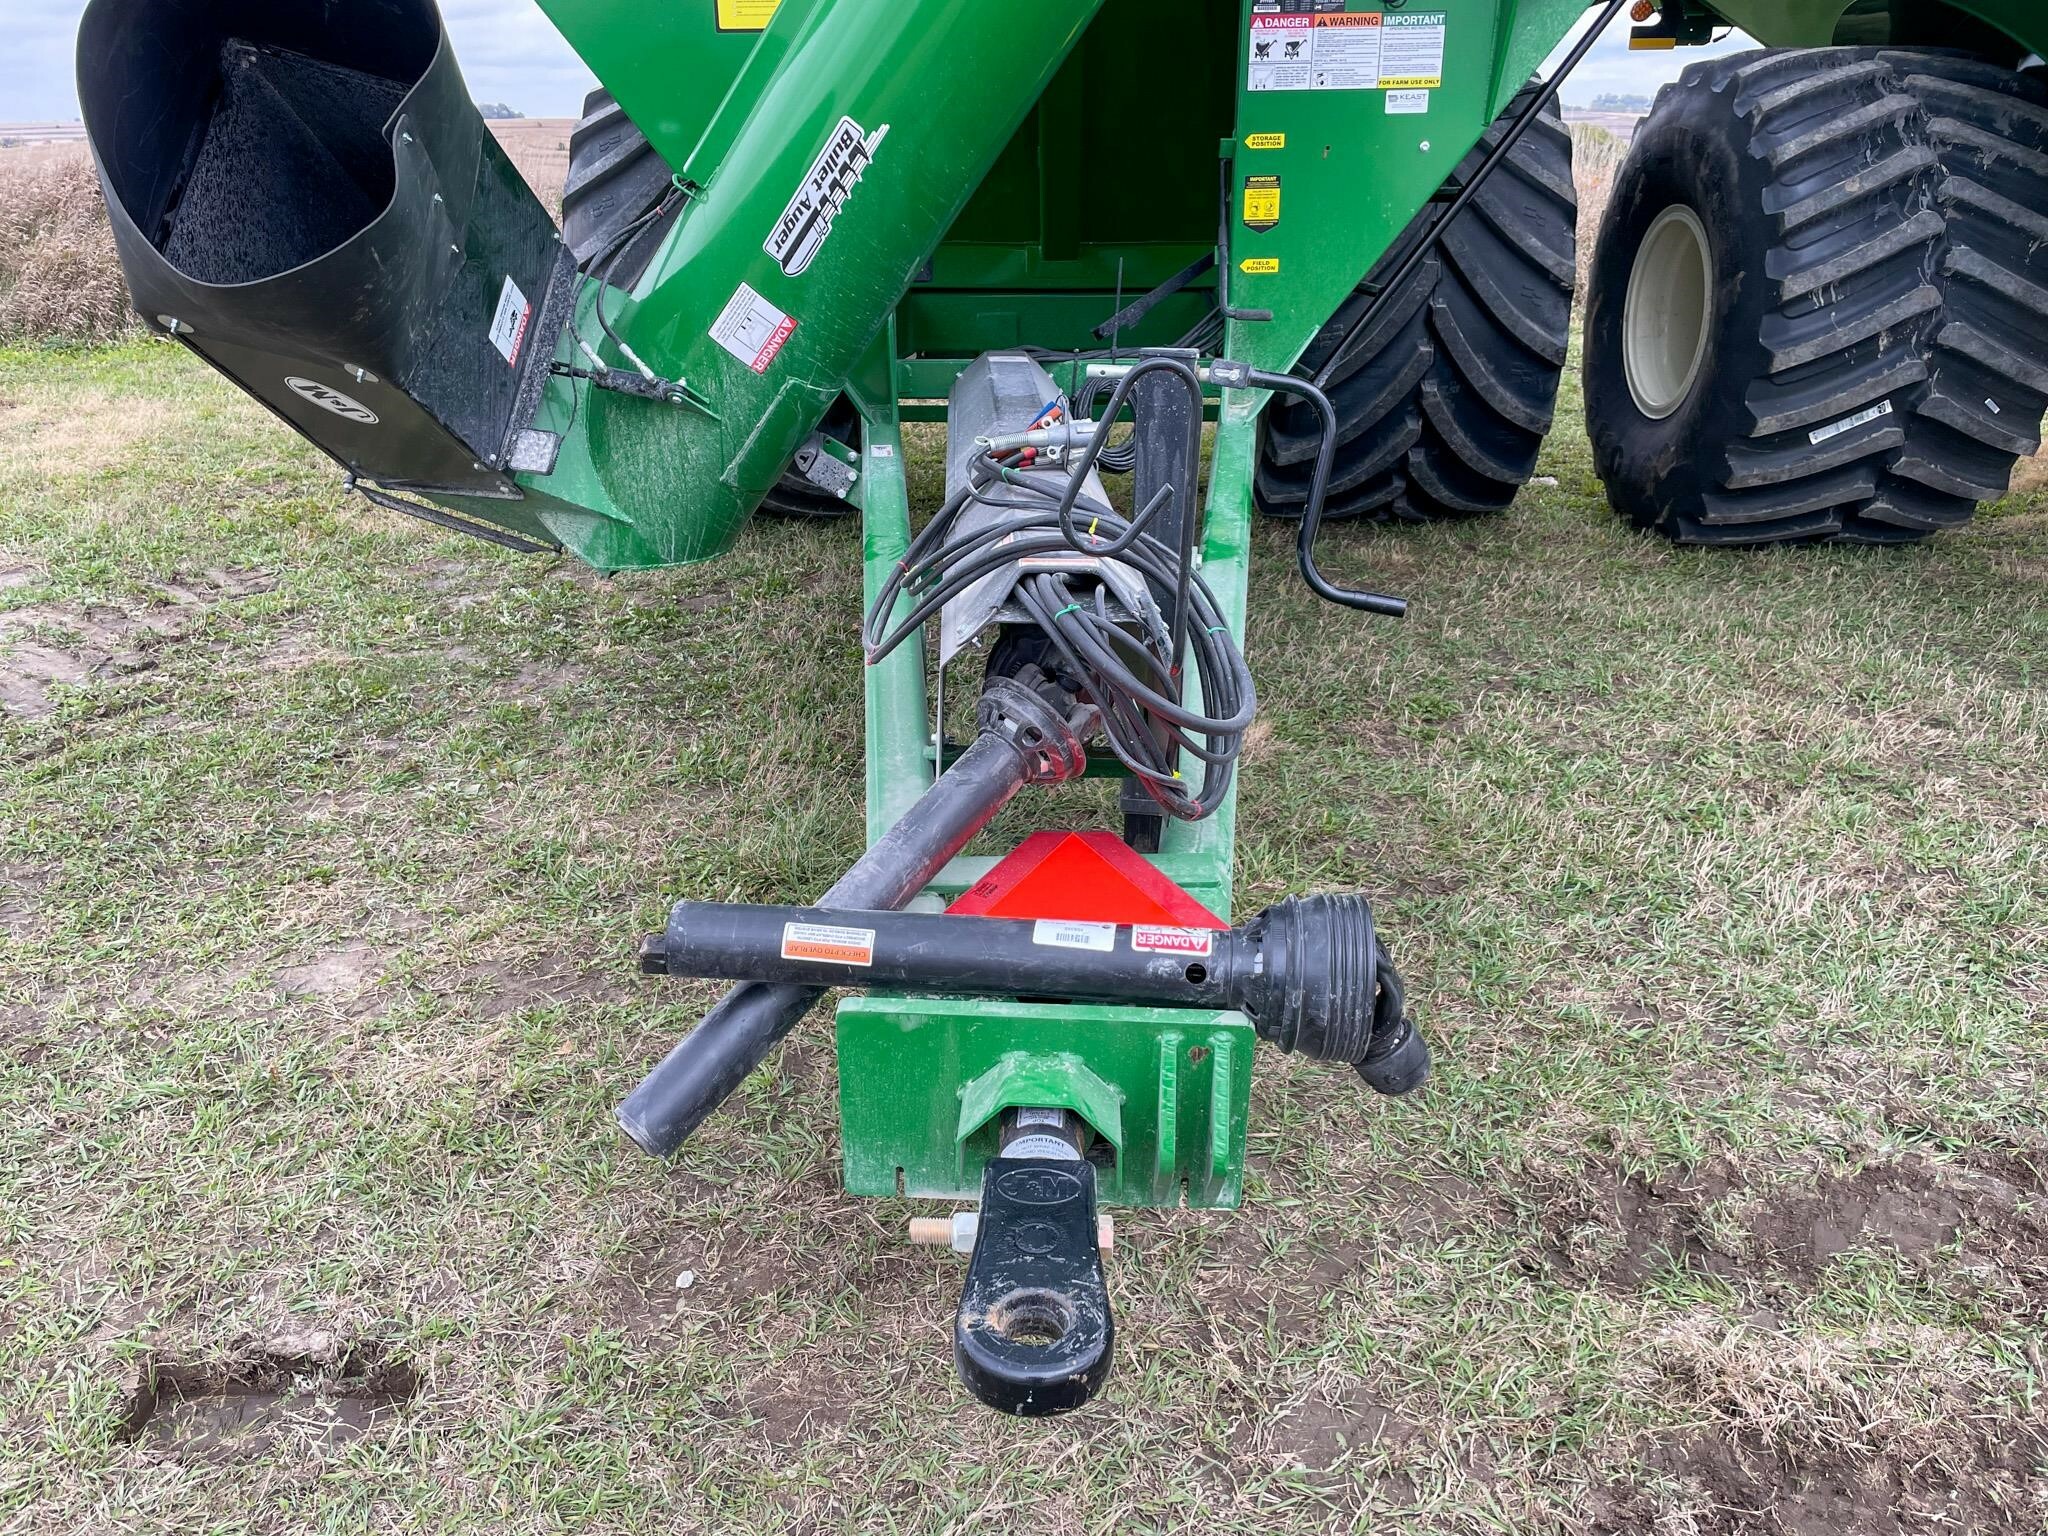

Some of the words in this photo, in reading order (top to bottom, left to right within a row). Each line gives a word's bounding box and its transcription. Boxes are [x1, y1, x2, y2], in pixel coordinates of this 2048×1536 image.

[1264, 17, 1310, 27] DANGER
[1329, 16, 1379, 26] WARNING
[1383, 14, 1445, 26] IMPORTANT
[811, 127, 855, 192] Bullet
[774, 190, 812, 254] Auger
[509, 315, 529, 366] DANGER
[753, 329, 788, 371] DANGER
[1136, 933, 1190, 947] DANGER
[789, 945, 823, 954] OVERLAP
[1014, 1136, 1065, 1149] IMPORTANT
